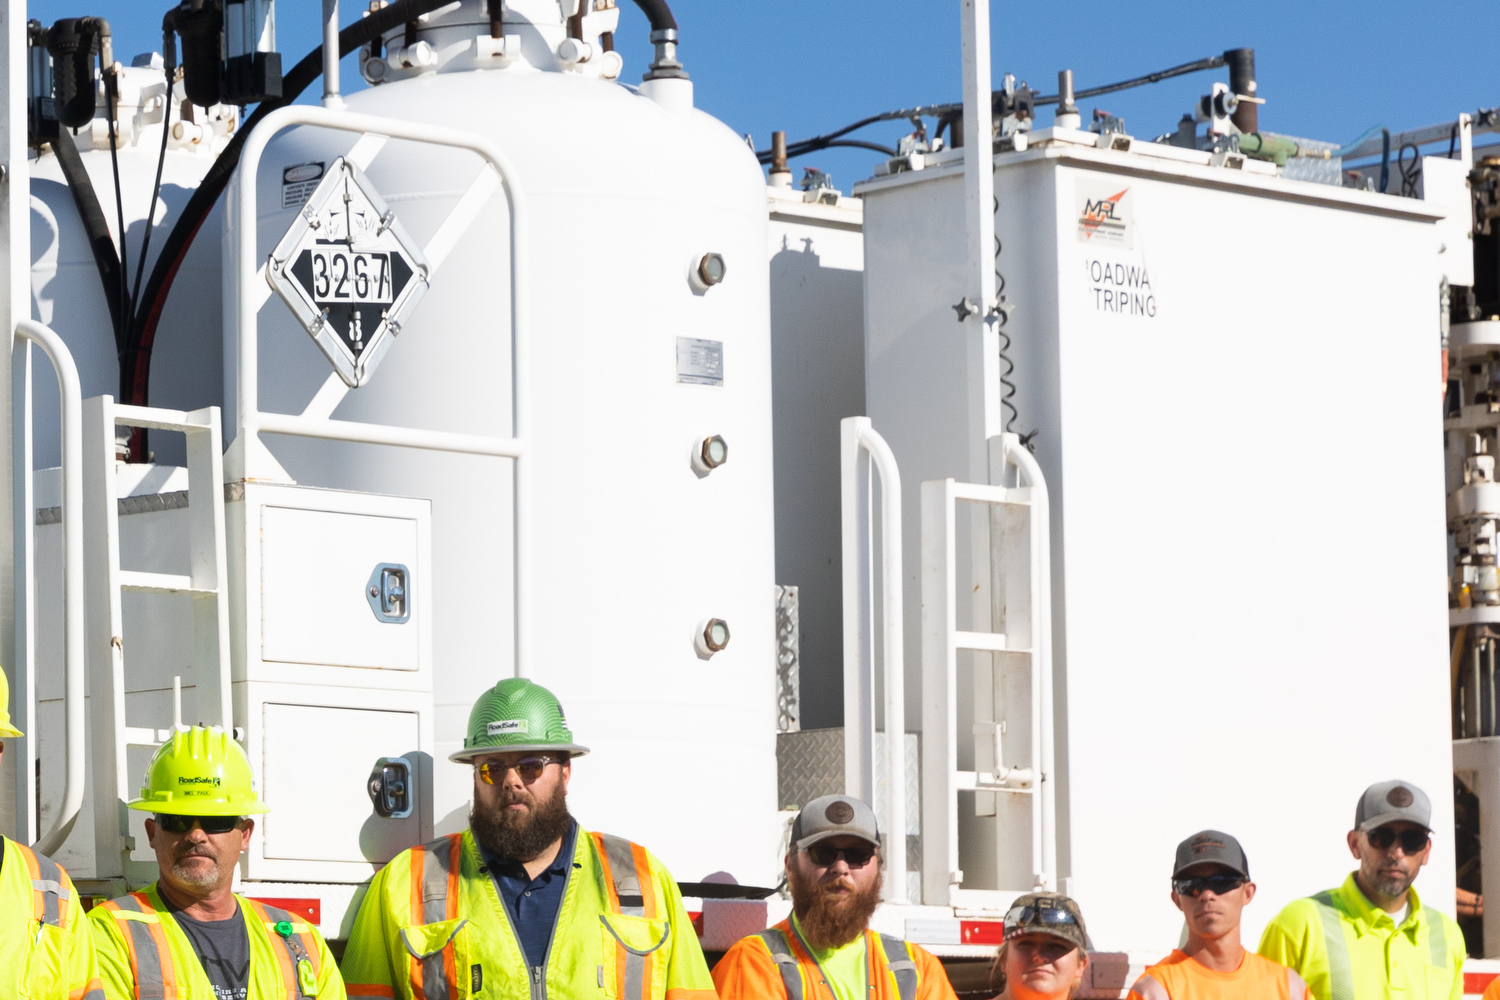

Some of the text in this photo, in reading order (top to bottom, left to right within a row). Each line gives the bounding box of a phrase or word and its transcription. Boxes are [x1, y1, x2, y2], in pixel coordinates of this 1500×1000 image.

[1084, 198, 1122, 220] MRL
[313, 253, 389, 299] 3267
[1086, 258, 1153, 287] OADWA
[1093, 287, 1157, 318] TRIPING
[488, 721, 519, 731] RoadSafe
[178, 776, 213, 785] RoadSafe
